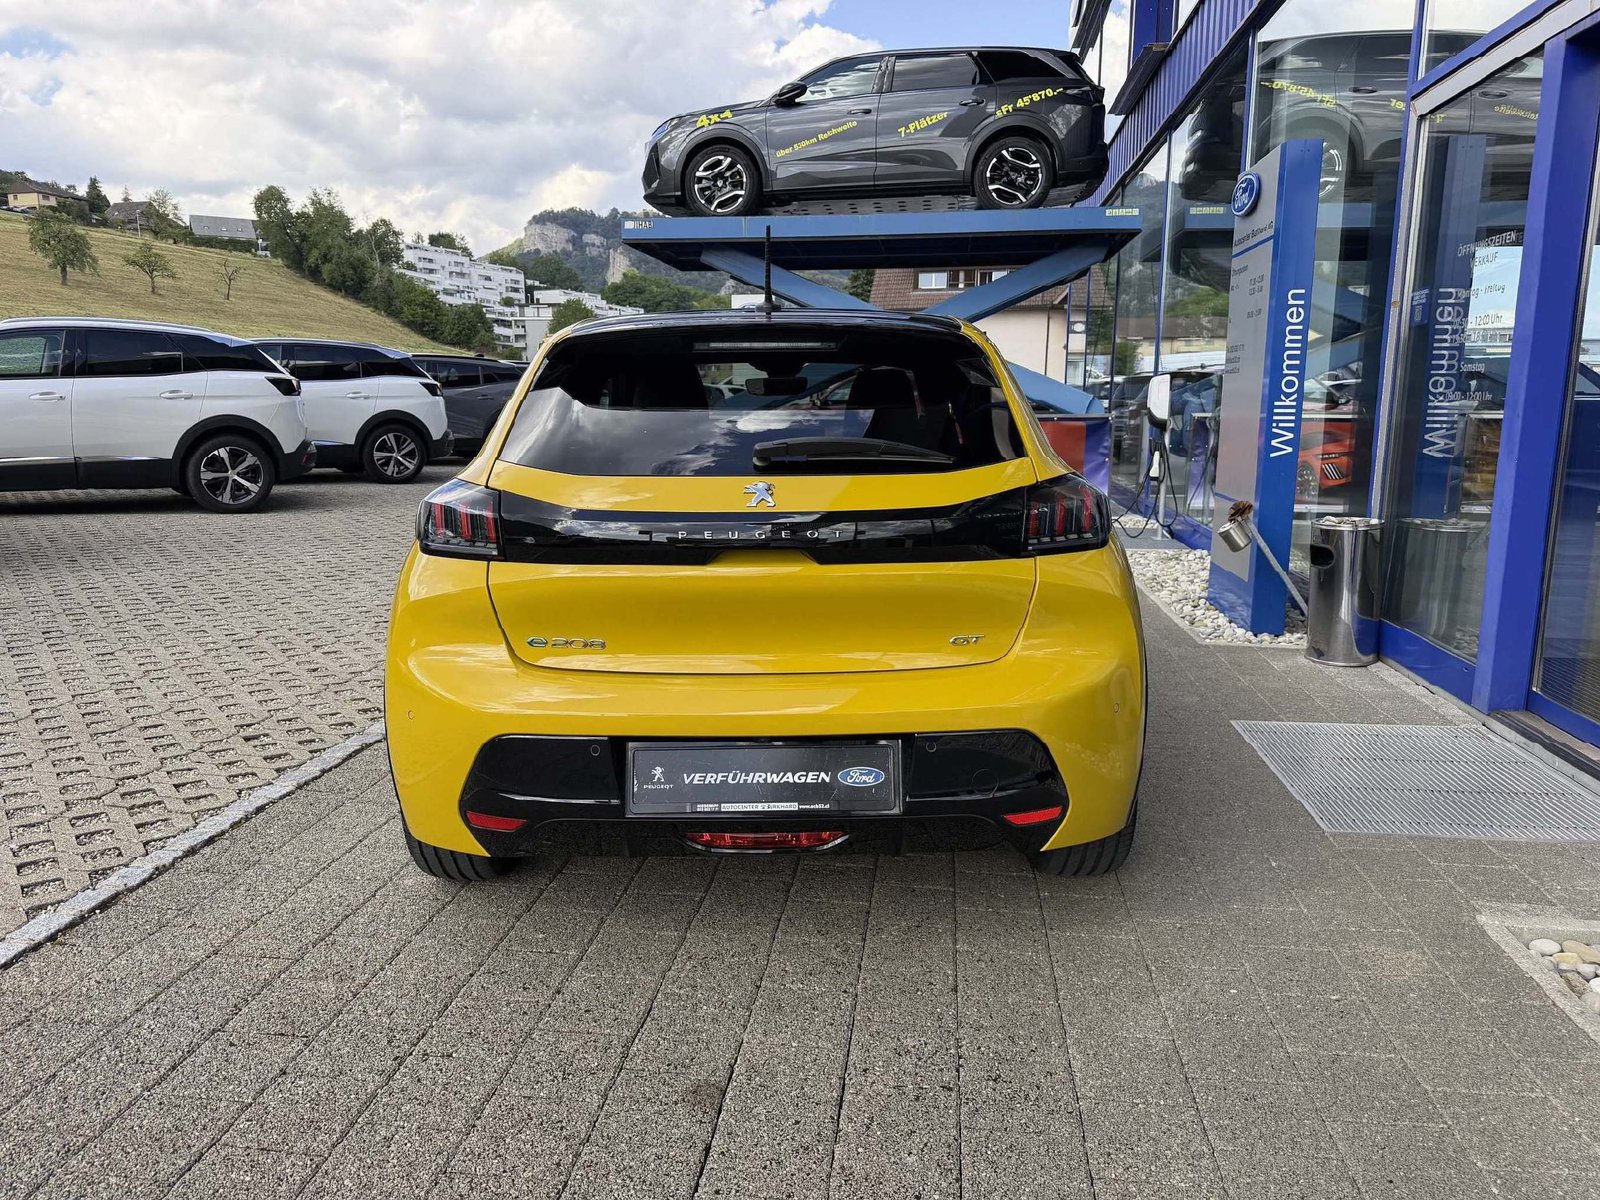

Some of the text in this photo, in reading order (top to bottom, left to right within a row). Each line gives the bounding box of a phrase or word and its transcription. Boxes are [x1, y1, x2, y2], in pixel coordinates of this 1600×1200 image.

[696, 109, 733, 128] 4x4
[897, 110, 949, 138] 7-Plätzer
[1458, 229, 1517, 257] ÖFFNUNGSZEITEN
[1470, 251, 1498, 269] VERKAUF
[1270, 289, 1306, 457] Willkommen
[1460, 361, 1485, 373] Samstag
[678, 530, 843, 539] PEUGEOT
[949, 634, 985, 646] GT
[683, 770, 831, 784] VERFÜHRWAGEN
